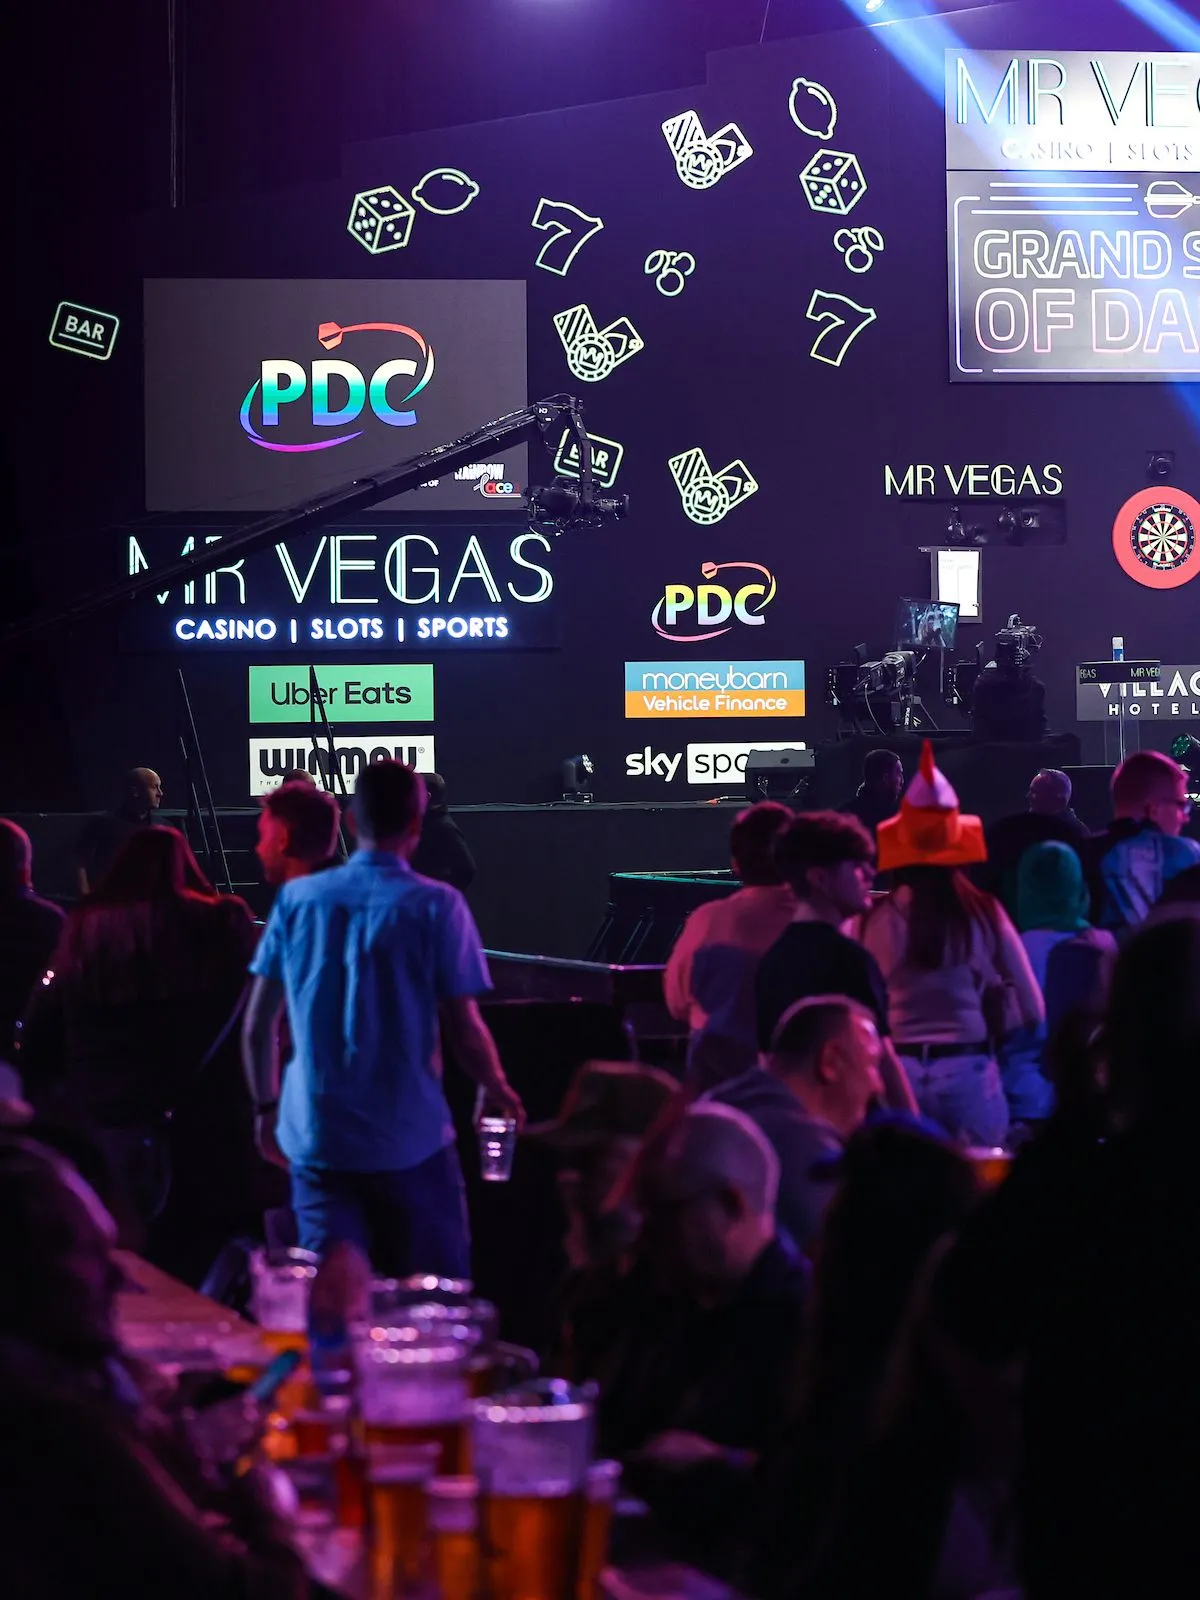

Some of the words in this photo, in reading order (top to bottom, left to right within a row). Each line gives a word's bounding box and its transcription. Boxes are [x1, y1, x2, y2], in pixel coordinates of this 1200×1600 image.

[956, 58, 1067, 126] MR
[973, 229, 1172, 279] GRAND
[65, 314, 105, 341] BAR
[974, 288, 1076, 354] OF
[261, 358, 418, 427] PDC
[568, 443, 609, 470] BR
[885, 464, 935, 496] MR
[943, 463, 1064, 496] VEGAS
[275, 533, 554, 605] VEGAS
[664, 583, 766, 626] PDC
[175, 618, 277, 641] CASINO
[311, 617, 384, 640] SLOTS
[417, 615, 509, 638] SPORTS
[271, 682, 338, 706] Uber
[344, 681, 412, 705] Eats
[642, 665, 788, 694] moneybarn
[642, 695, 710, 711] Vehicle
[715, 695, 788, 711] Finance
[625, 746, 683, 782] sky
